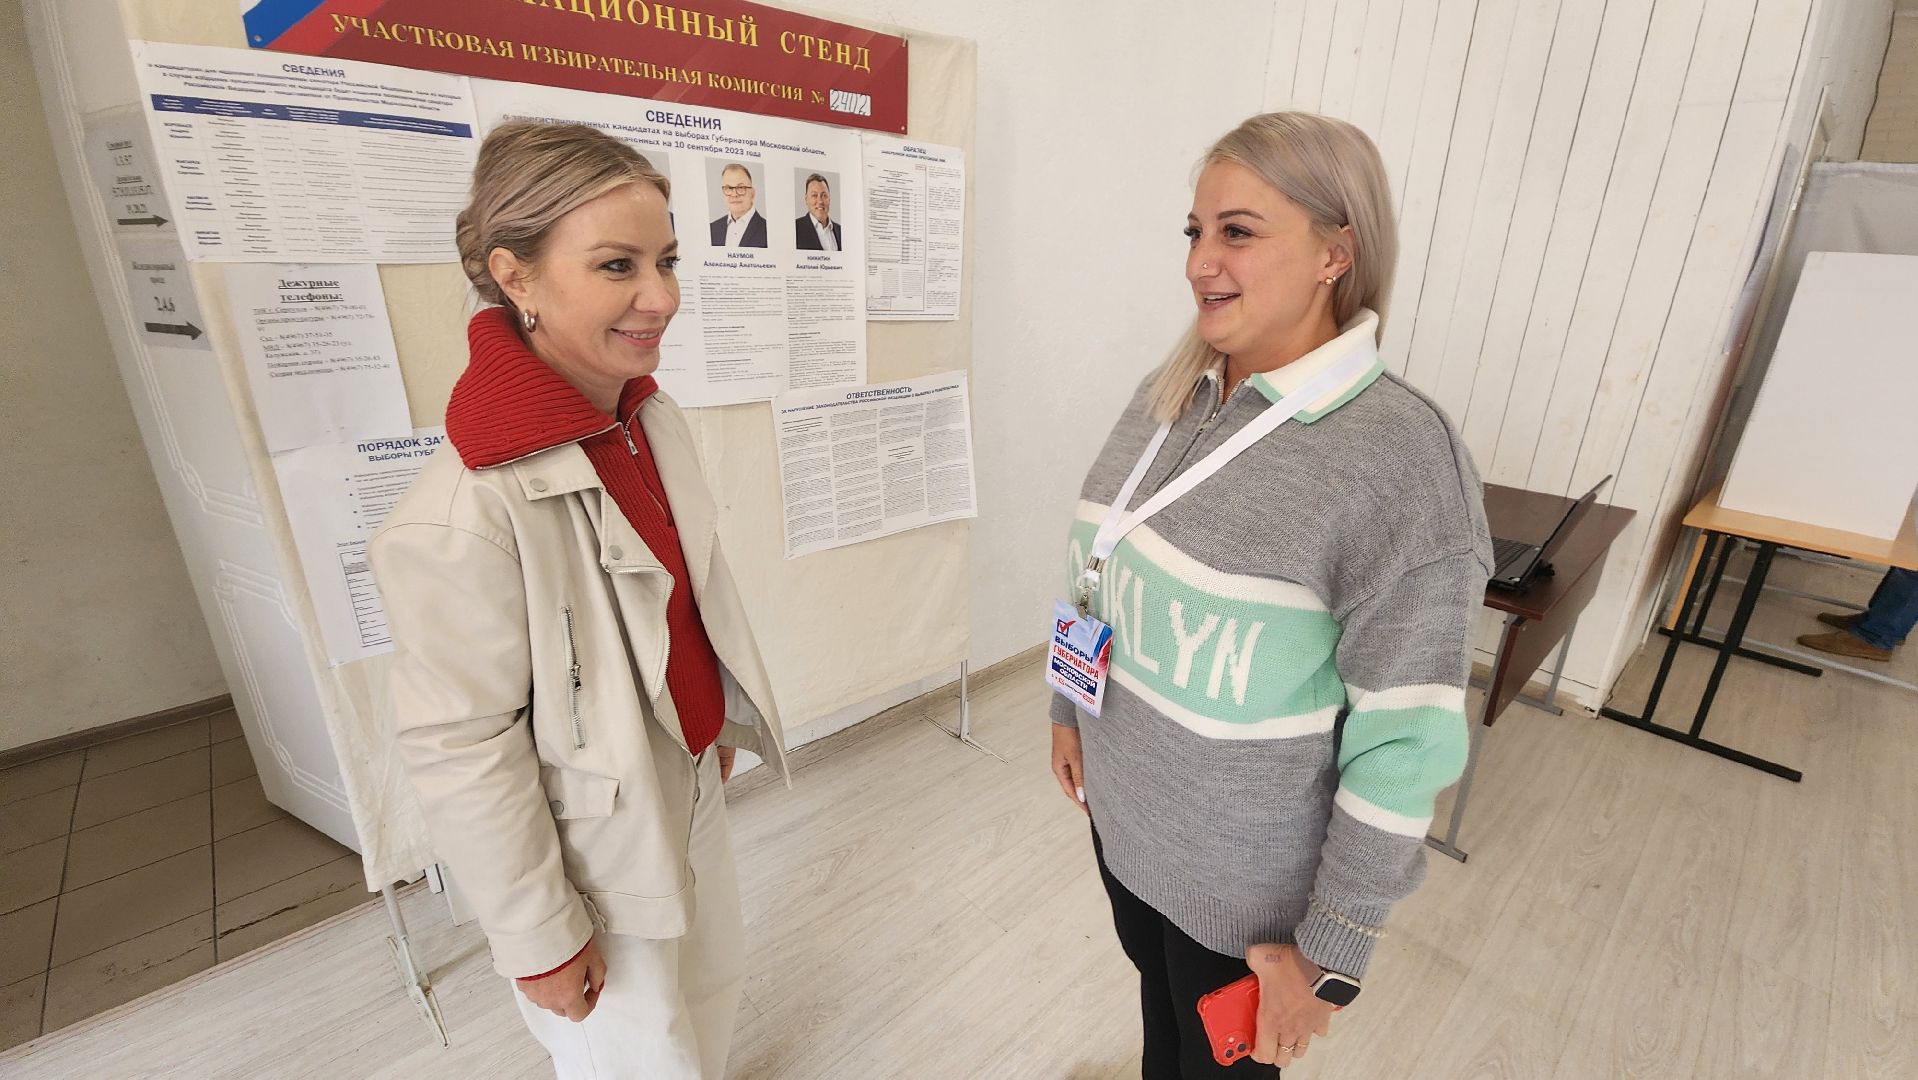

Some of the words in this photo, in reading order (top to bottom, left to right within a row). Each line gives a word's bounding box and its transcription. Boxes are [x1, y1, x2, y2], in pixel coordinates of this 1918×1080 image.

[330, 13, 515, 58] УЧАСТКОВАЯ
[520, 43, 703, 85] ИЗБИРАТЕЛЬНАЯ
[707, 72, 803, 101] КОМИССИЯ
[811, 90, 825, 105] №
[780, 31, 871, 73] СТЕНД
[282, 64, 346, 78] СВЕДЕНИЯ
[645, 110, 722, 130] СВЕДЕНИЯ
[612, 124, 661, 136] кандидатах
[675, 130, 710, 142] выборах
[711, 134, 758, 147] Губернатора
[759, 140, 801, 152] Московской
[675, 141, 685, 149] 10
[686, 144, 723, 154] сентября
[725, 147, 744, 155] 2023
[278, 279, 340, 289] Дежурные
[280, 293, 344, 303] телефоны:
[846, 387, 913, 400] ОТВЕТСТВЕННОСТЬ
[357, 438, 422, 453] ПОРЯДОК
[368, 451, 412, 462] ВЫБОРЫ
[1054, 635, 1094, 664] ВЫБОРЫ
[1053, 645, 1099, 680] ГУБЕРНАТОРА
[1053, 657, 1096, 689] МОСКОВСКОЙ
[1059, 668, 1089, 691] ОБЛАСТИ
